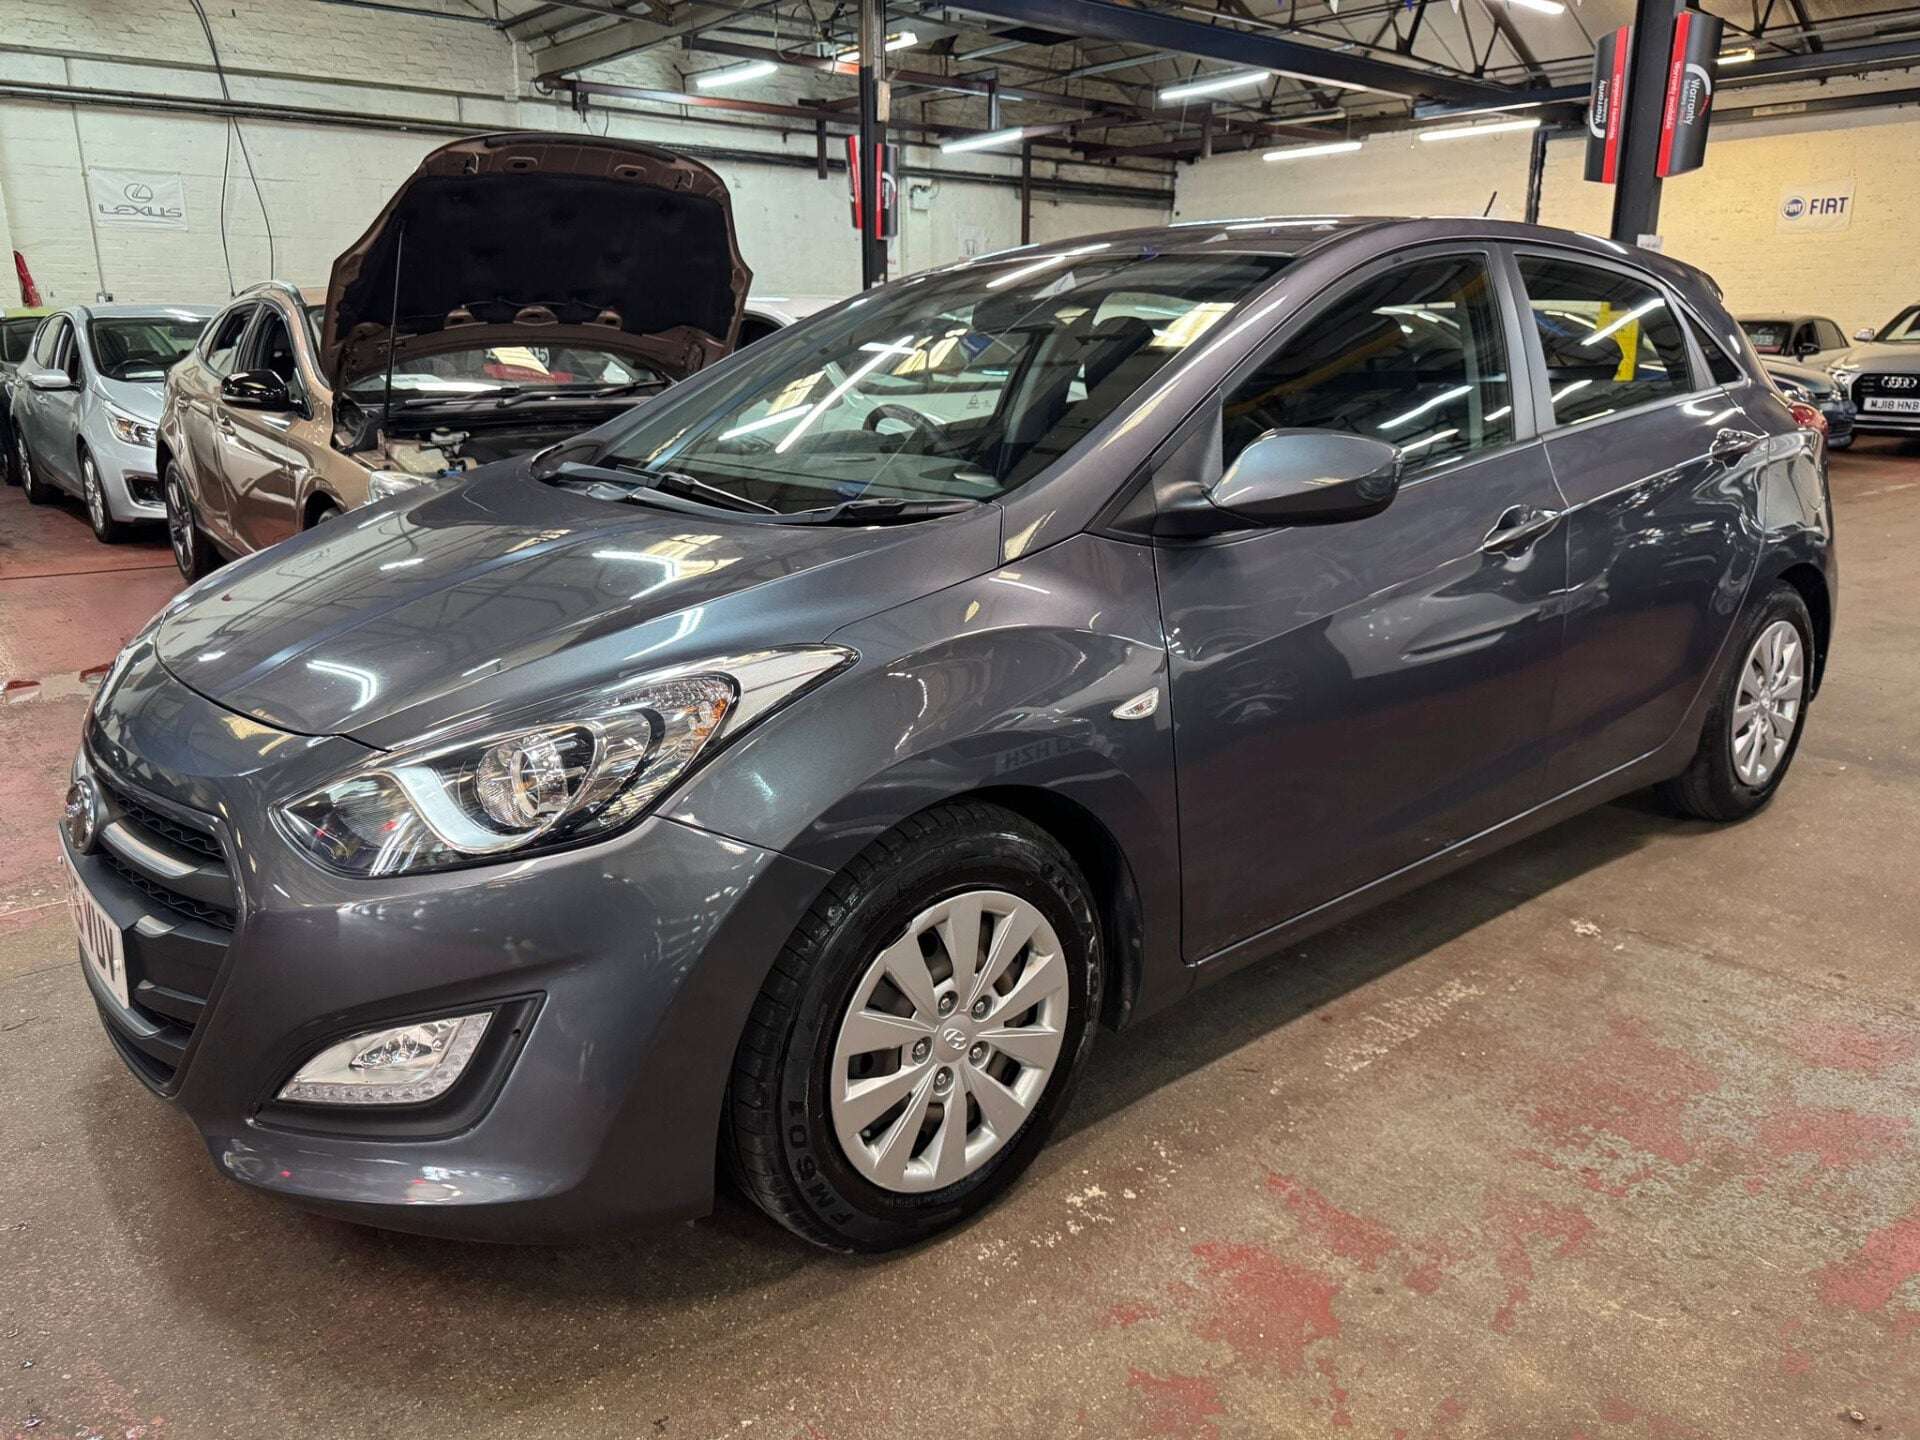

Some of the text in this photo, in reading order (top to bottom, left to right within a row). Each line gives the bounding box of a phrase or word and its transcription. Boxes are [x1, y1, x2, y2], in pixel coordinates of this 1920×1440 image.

[1595, 80, 1607, 124] Warranty
[1683, 79, 1700, 125] Warranty
[99, 203, 182, 217] LEXUS
[1809, 197, 1848, 215] FIAT
